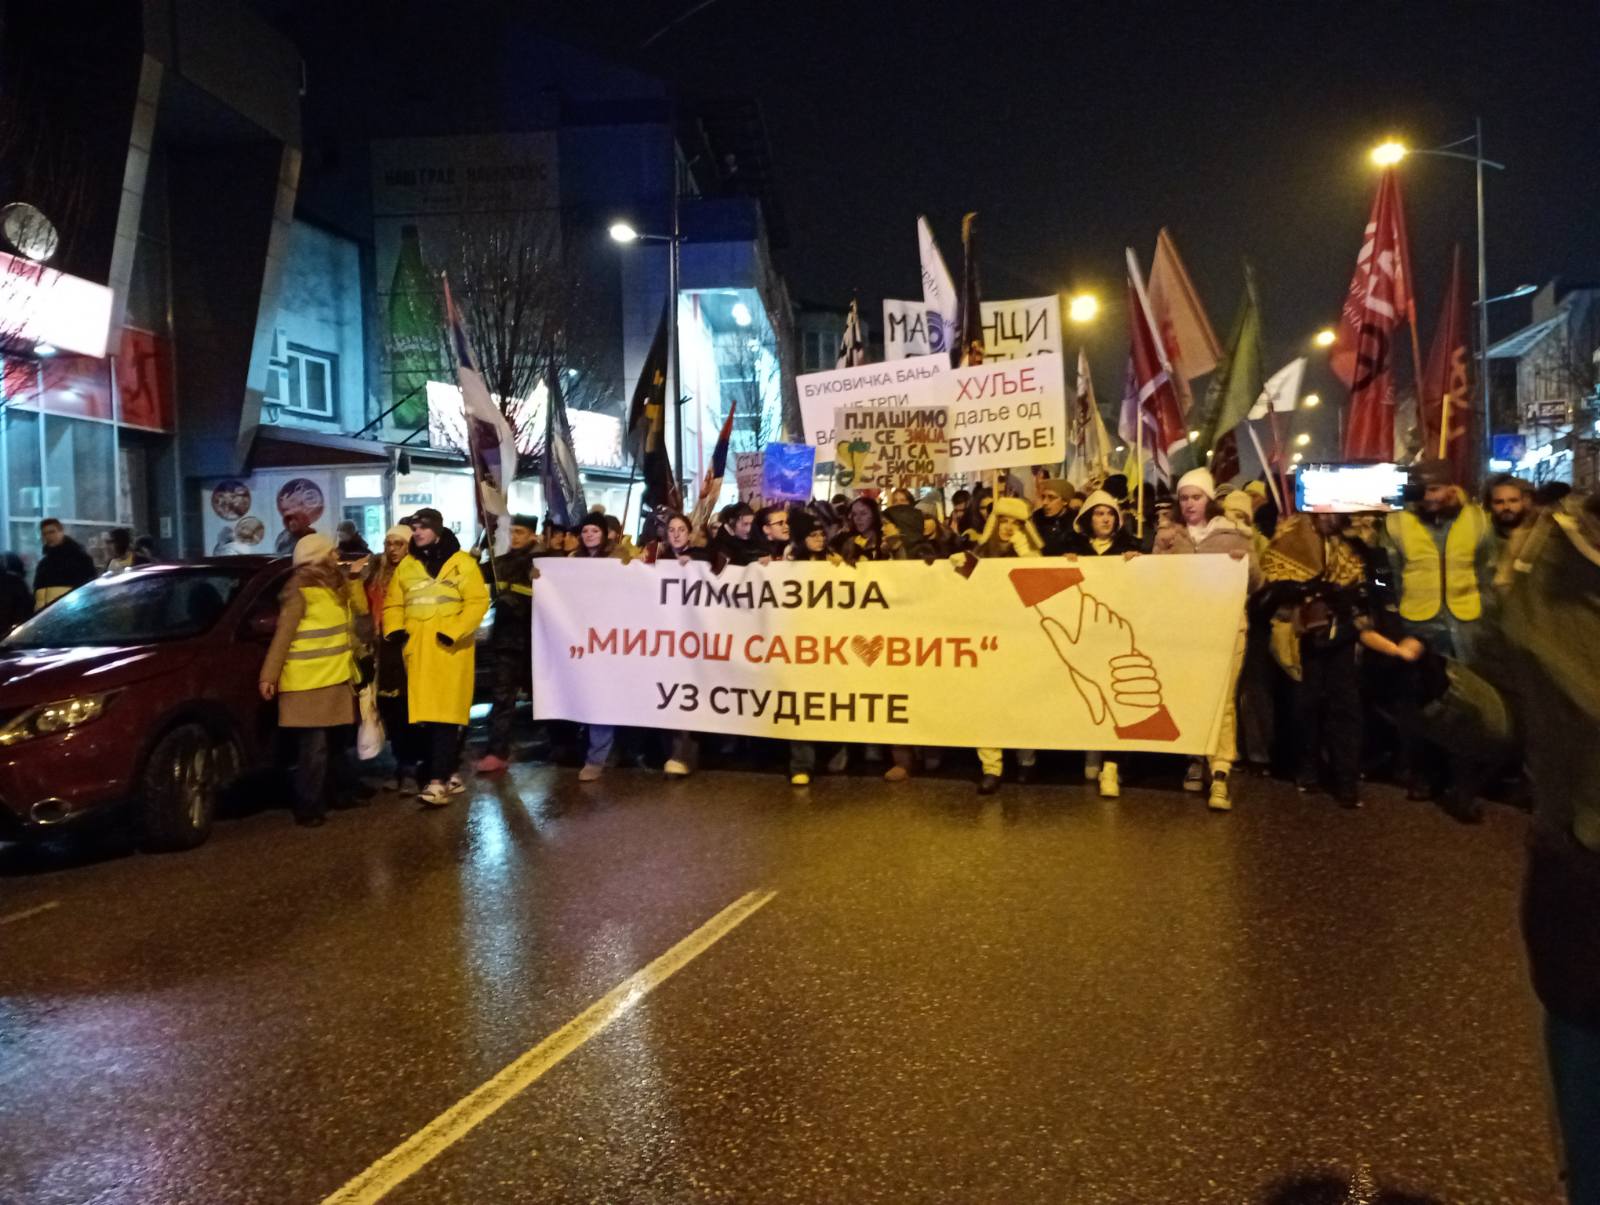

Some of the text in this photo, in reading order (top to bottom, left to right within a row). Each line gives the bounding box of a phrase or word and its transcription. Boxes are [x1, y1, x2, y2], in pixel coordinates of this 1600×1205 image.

[804, 364, 941, 396] БУКОВИЧКА БАЊА
[845, 410, 947, 430] ПЛАШИМО
[1016, 402, 1041, 421] од
[875, 430, 896, 445] СЕ
[949, 427, 1055, 458] БУКУЉЕ!
[878, 444, 929, 461] АЛ СА
[886, 460, 934, 475] БИСМО
[876, 474, 895, 489] СЕ
[660, 578, 889, 609] ГИМНАЗИЈА
[656, 682, 910, 726] УЗ СТУДЕНТЕ
